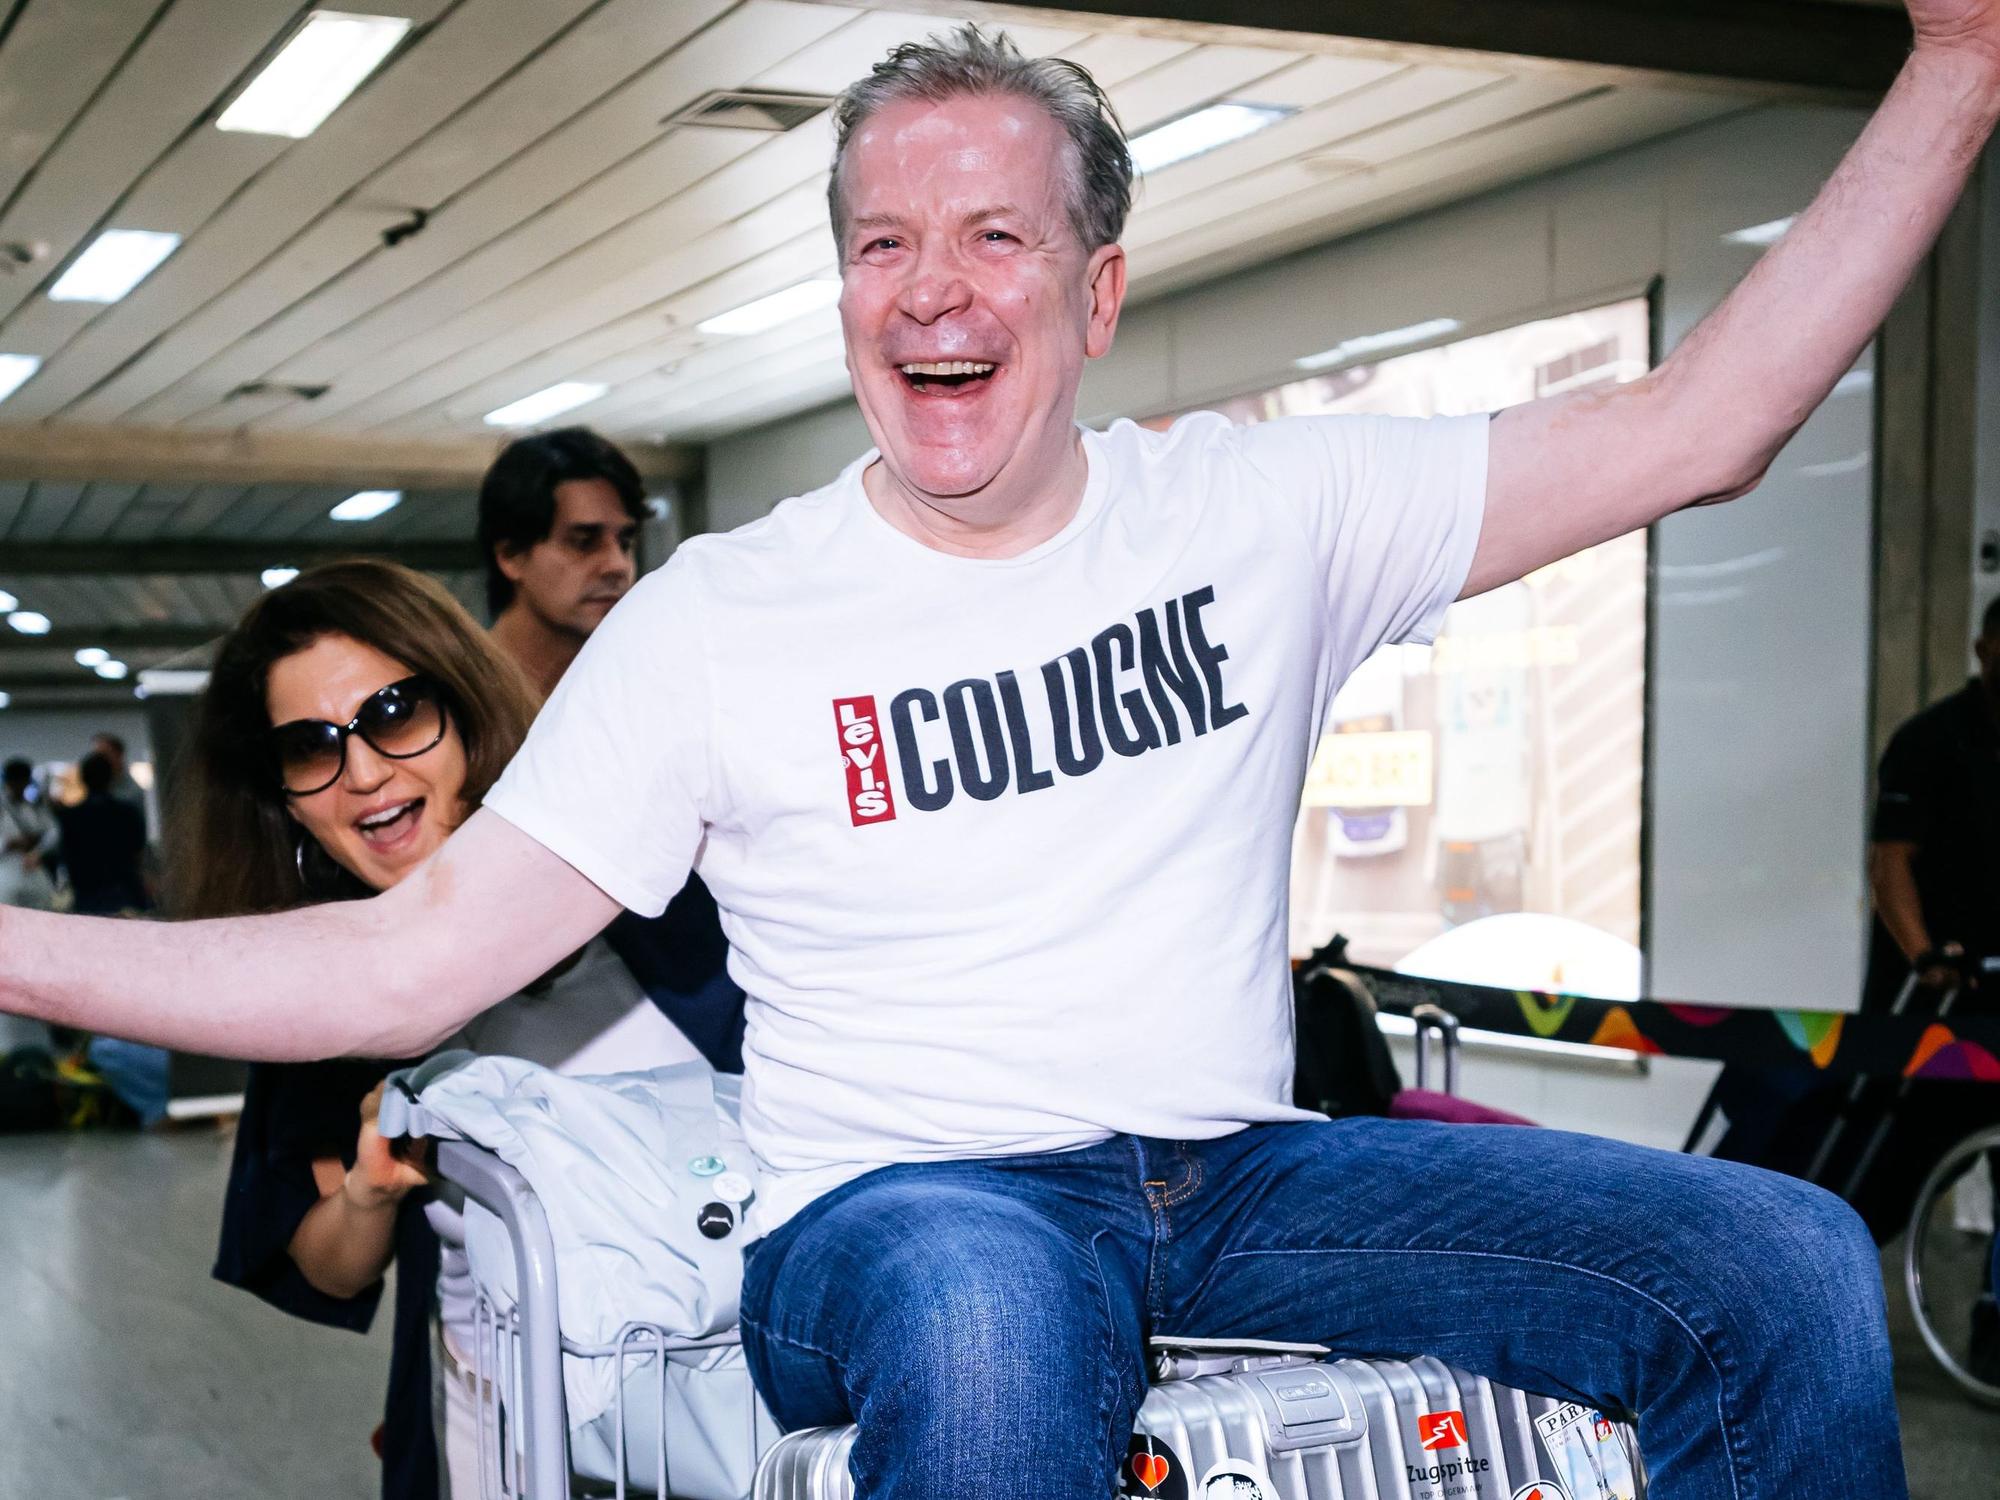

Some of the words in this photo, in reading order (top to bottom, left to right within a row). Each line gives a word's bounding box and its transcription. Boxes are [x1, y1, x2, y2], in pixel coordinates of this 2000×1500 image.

[890, 585, 1249, 812] COLOGNE
[1546, 1403, 1588, 1431] PARI
[1406, 1457, 1489, 1484] Zugspitze
